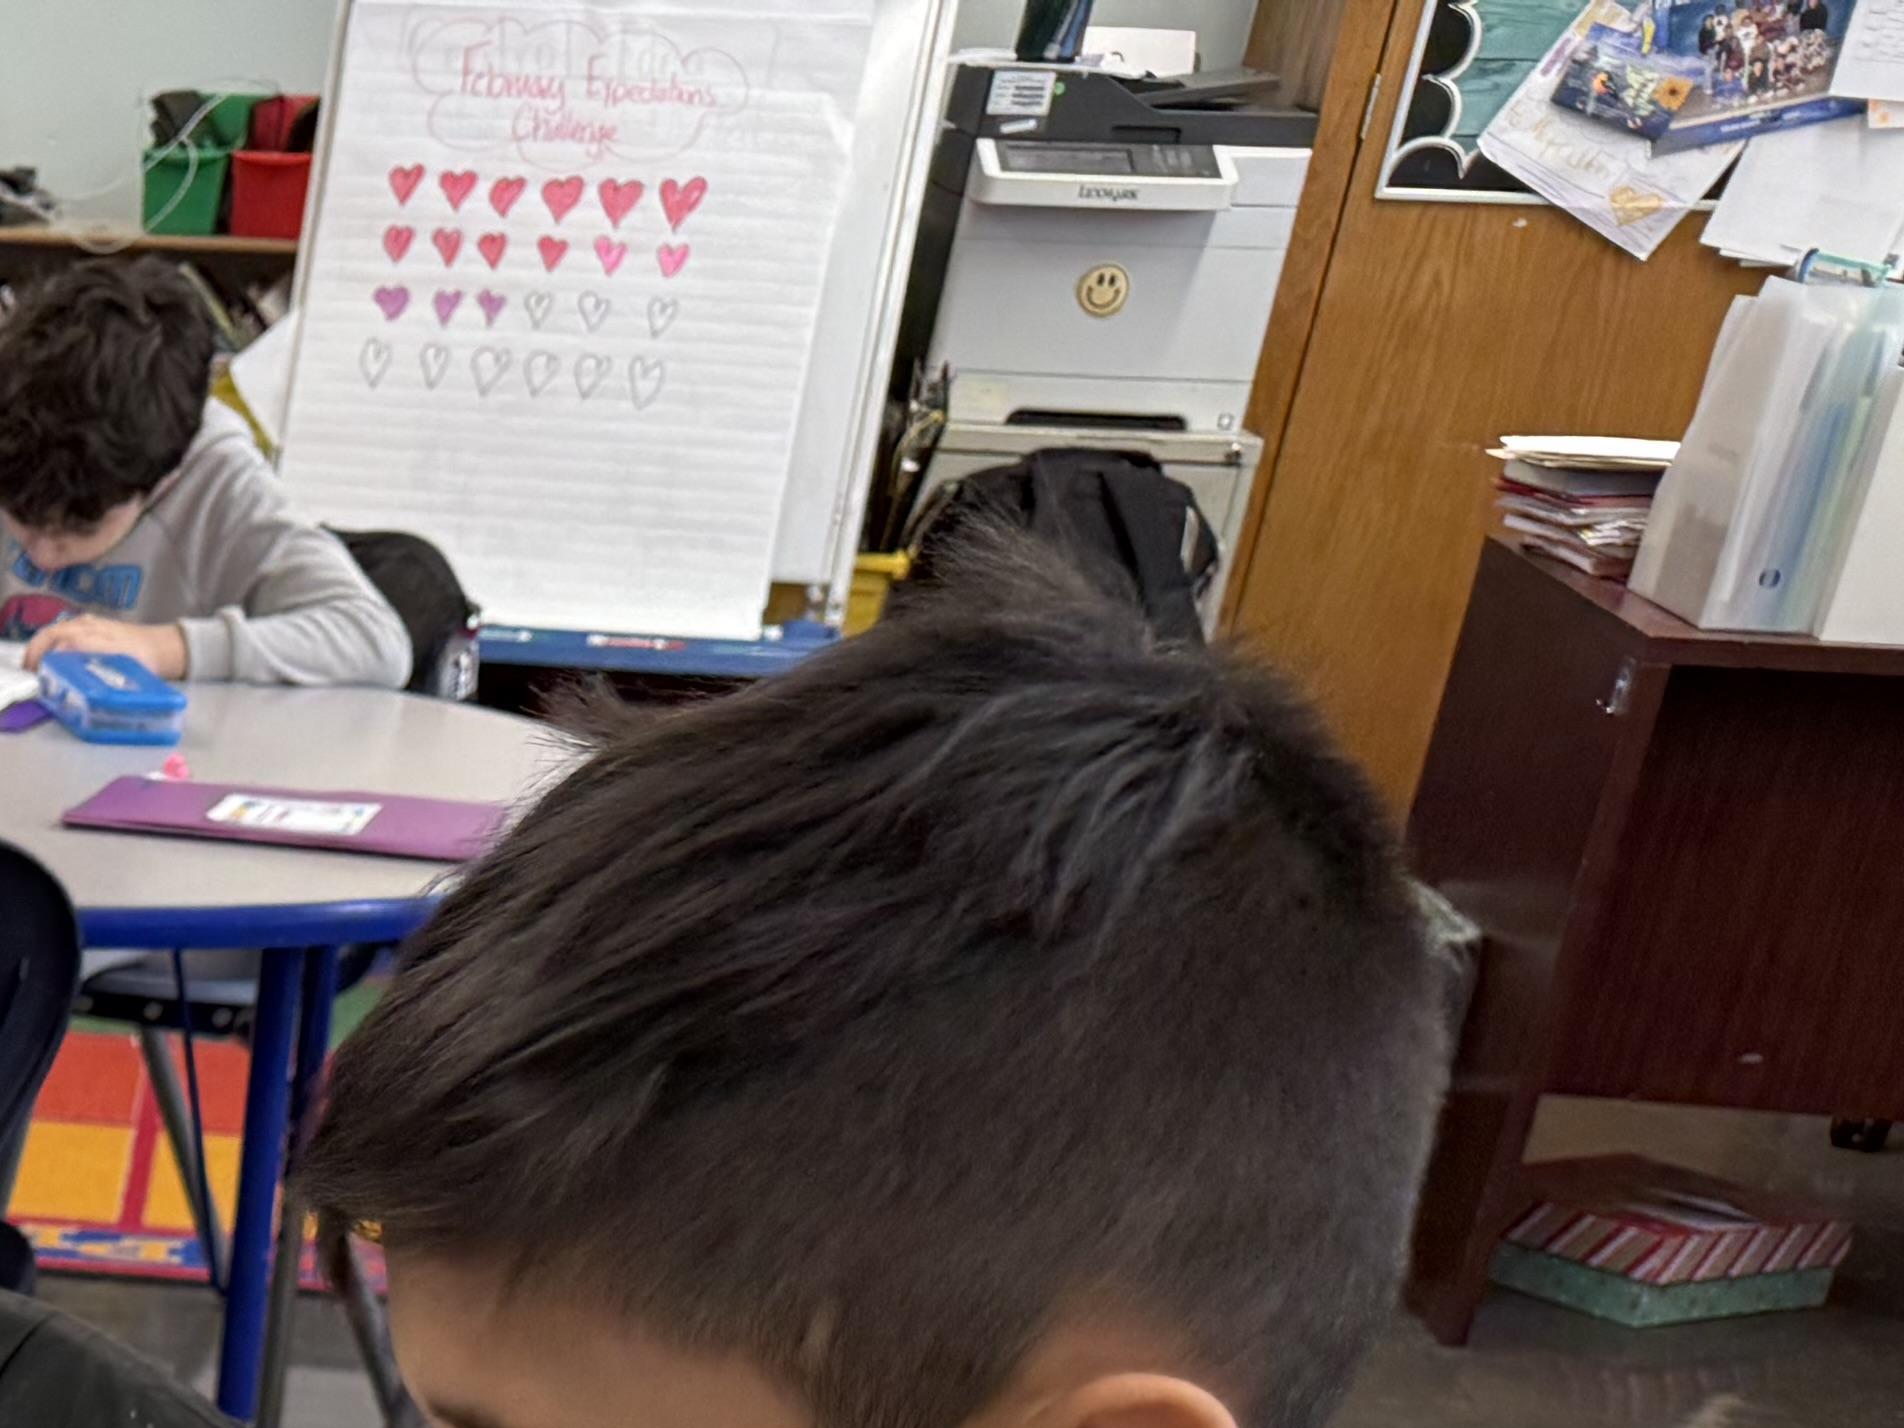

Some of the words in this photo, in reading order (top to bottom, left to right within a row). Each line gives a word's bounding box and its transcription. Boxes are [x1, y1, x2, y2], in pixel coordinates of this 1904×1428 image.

[461, 40, 566, 113] February
[586, 53, 717, 109] Expectations
[511, 101, 618, 159] Challenge
